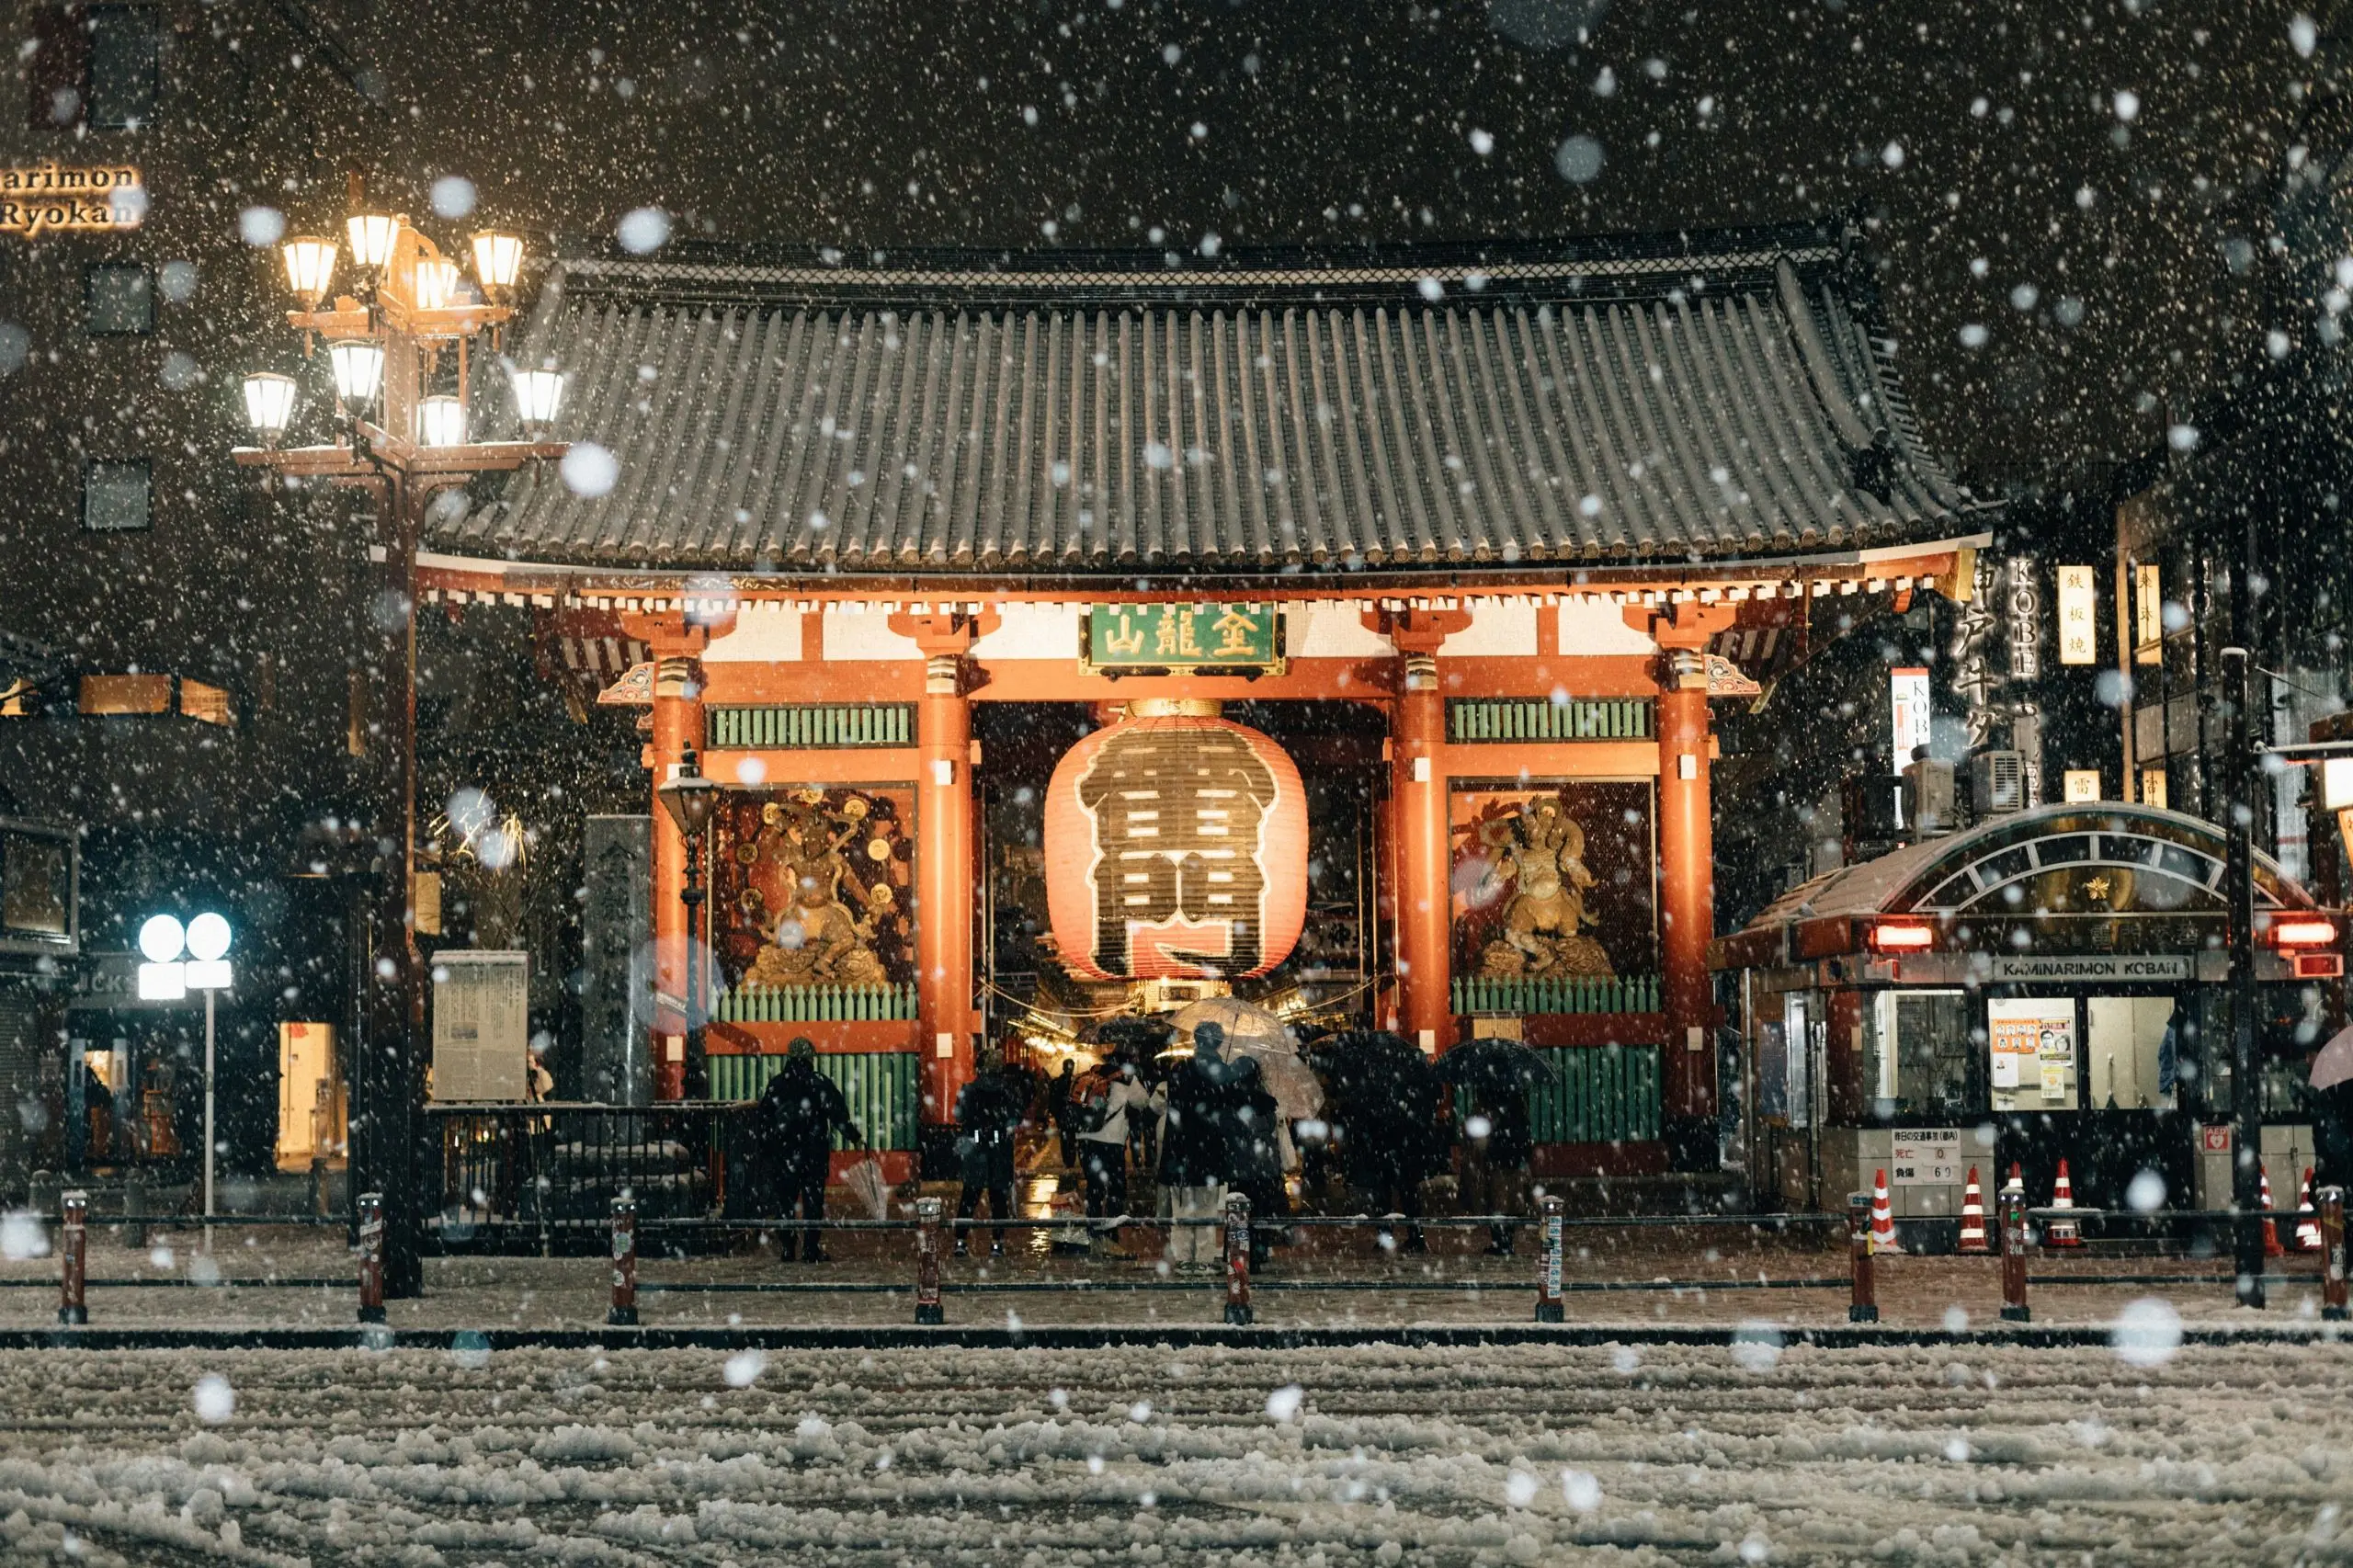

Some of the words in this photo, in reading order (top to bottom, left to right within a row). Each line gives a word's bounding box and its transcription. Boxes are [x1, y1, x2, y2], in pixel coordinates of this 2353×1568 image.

[3, 164, 133, 189] arimon
[0, 200, 133, 232] Ryokan
[2015, 561, 2037, 675] KOBE
[2066, 573, 2086, 653] 鉄板焼
[1079, 726, 1278, 980] 雷門
[2004, 962, 2116, 976] KAMINARIMON
[2124, 961, 2177, 975] KOBAN
[2208, 1128, 2226, 1136] AED
[1895, 1149, 1914, 1159] 死亡
[1937, 1148, 1944, 1159] 0
